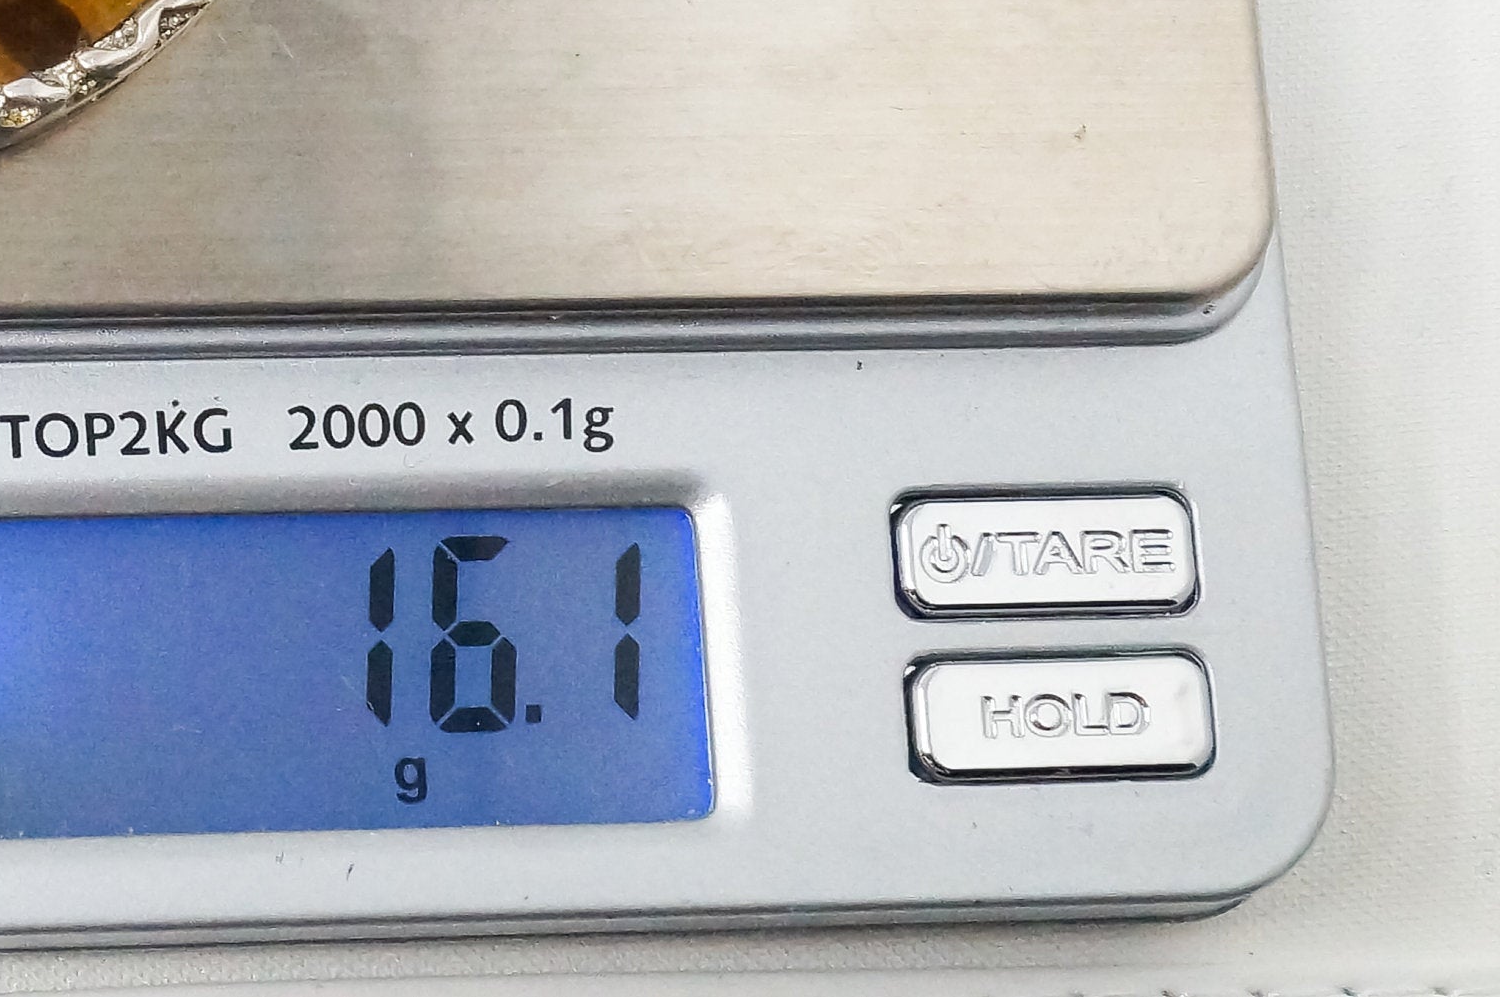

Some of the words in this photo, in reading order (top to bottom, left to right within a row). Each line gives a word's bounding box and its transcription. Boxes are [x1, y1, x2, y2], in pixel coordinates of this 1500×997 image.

[289, 401, 426, 450] 2000
[495, 397, 615, 453] 0.1g
[366, 534, 642, 734] 16.1
[980, 691, 1152, 739] HOLD
[393, 755, 429, 804] g
